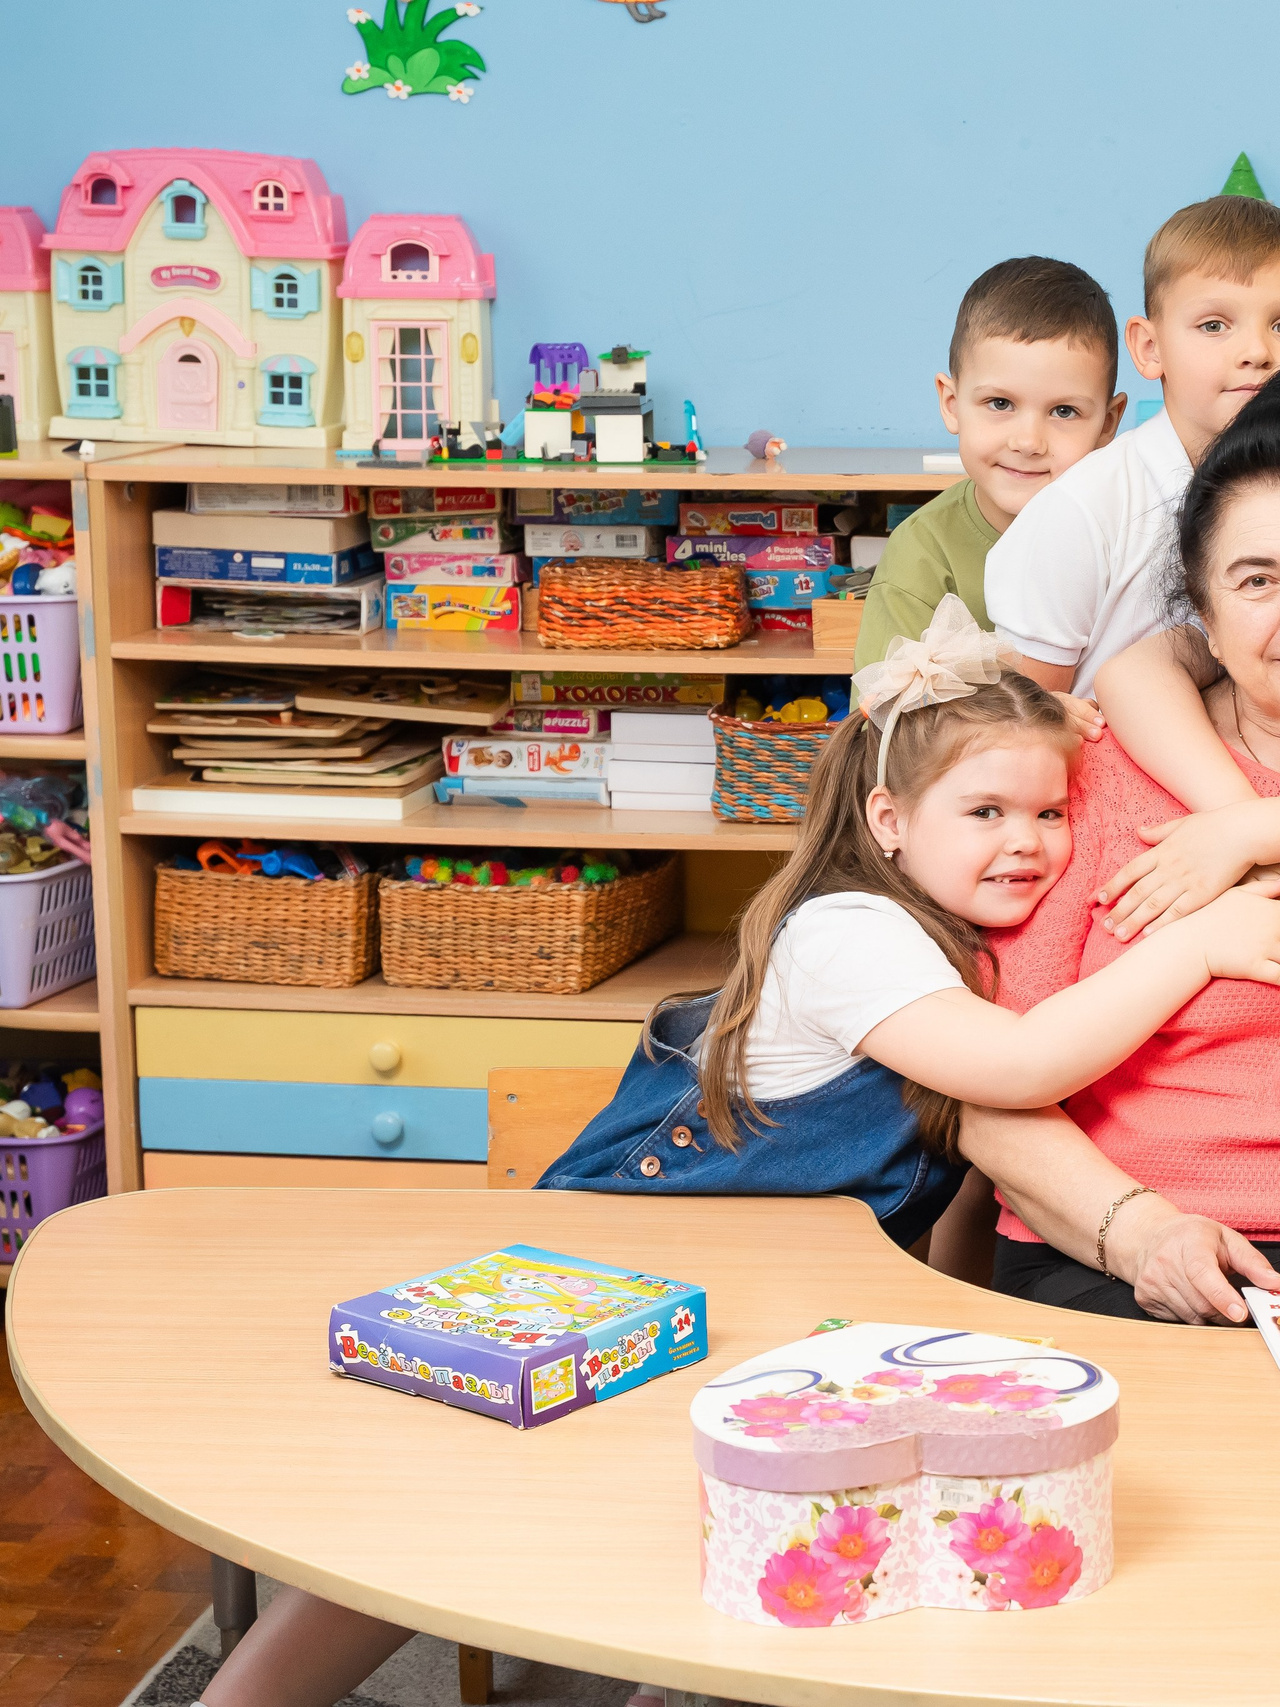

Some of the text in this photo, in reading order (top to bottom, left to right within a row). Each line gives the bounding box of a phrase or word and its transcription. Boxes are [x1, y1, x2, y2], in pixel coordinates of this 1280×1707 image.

[444, 494, 486, 504] PUZZLE
[674, 539, 692, 560] 4
[695, 541, 727, 553] mini
[774, 546, 804, 555] People
[767, 553, 803, 562] Jigsaws
[799, 578, 811, 591] 12
[551, 717, 588, 727] PUZZLE
[388, 1309, 548, 1344] Весёлые
[419, 1307, 546, 1332] пазлы
[677, 1313, 691, 1332] 24
[587, 1324, 659, 1378] Весёлые
[340, 1336, 510, 1400] Весёлые пазлы
[598, 1341, 652, 1385] пазлы
